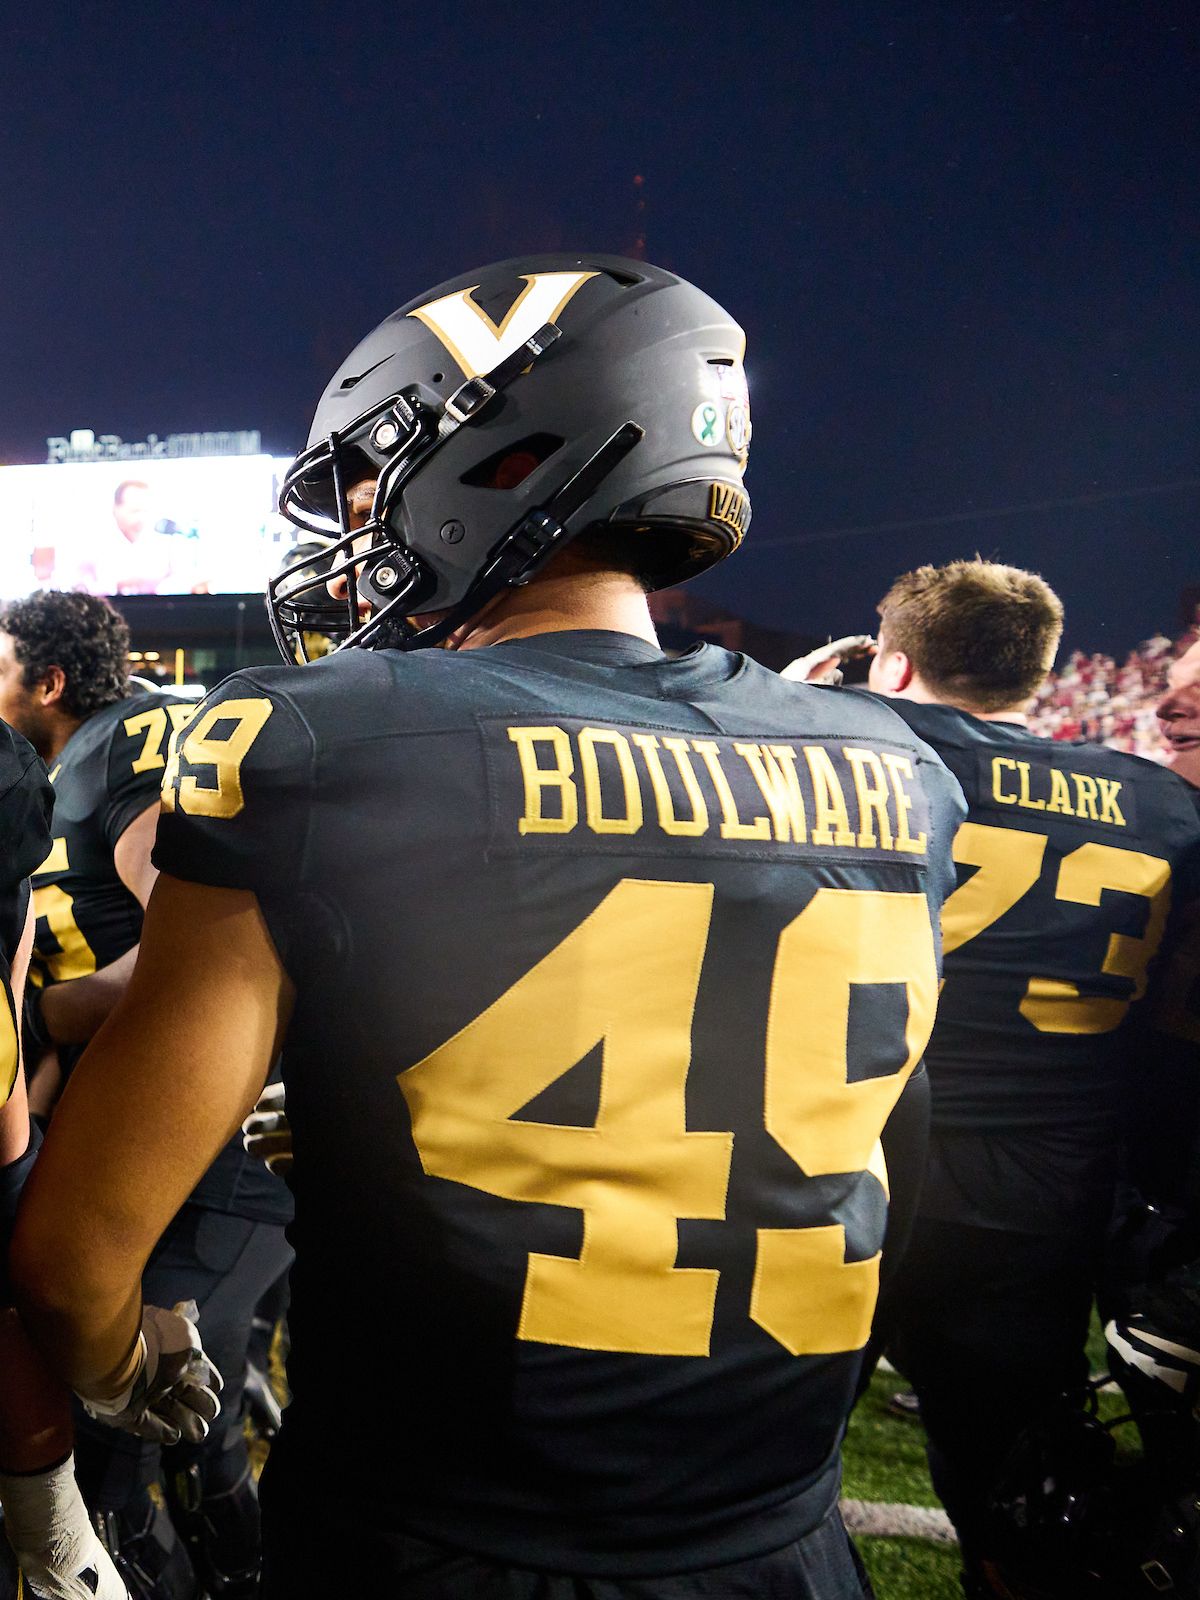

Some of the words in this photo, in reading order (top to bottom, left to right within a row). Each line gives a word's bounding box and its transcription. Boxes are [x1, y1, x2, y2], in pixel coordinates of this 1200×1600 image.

[406, 271, 601, 379] V
[507, 726, 927, 854] BOULWARE
[992, 756, 1127, 827] CLARK
[940, 821, 1173, 1035] 73
[396, 877, 940, 1357] 49
